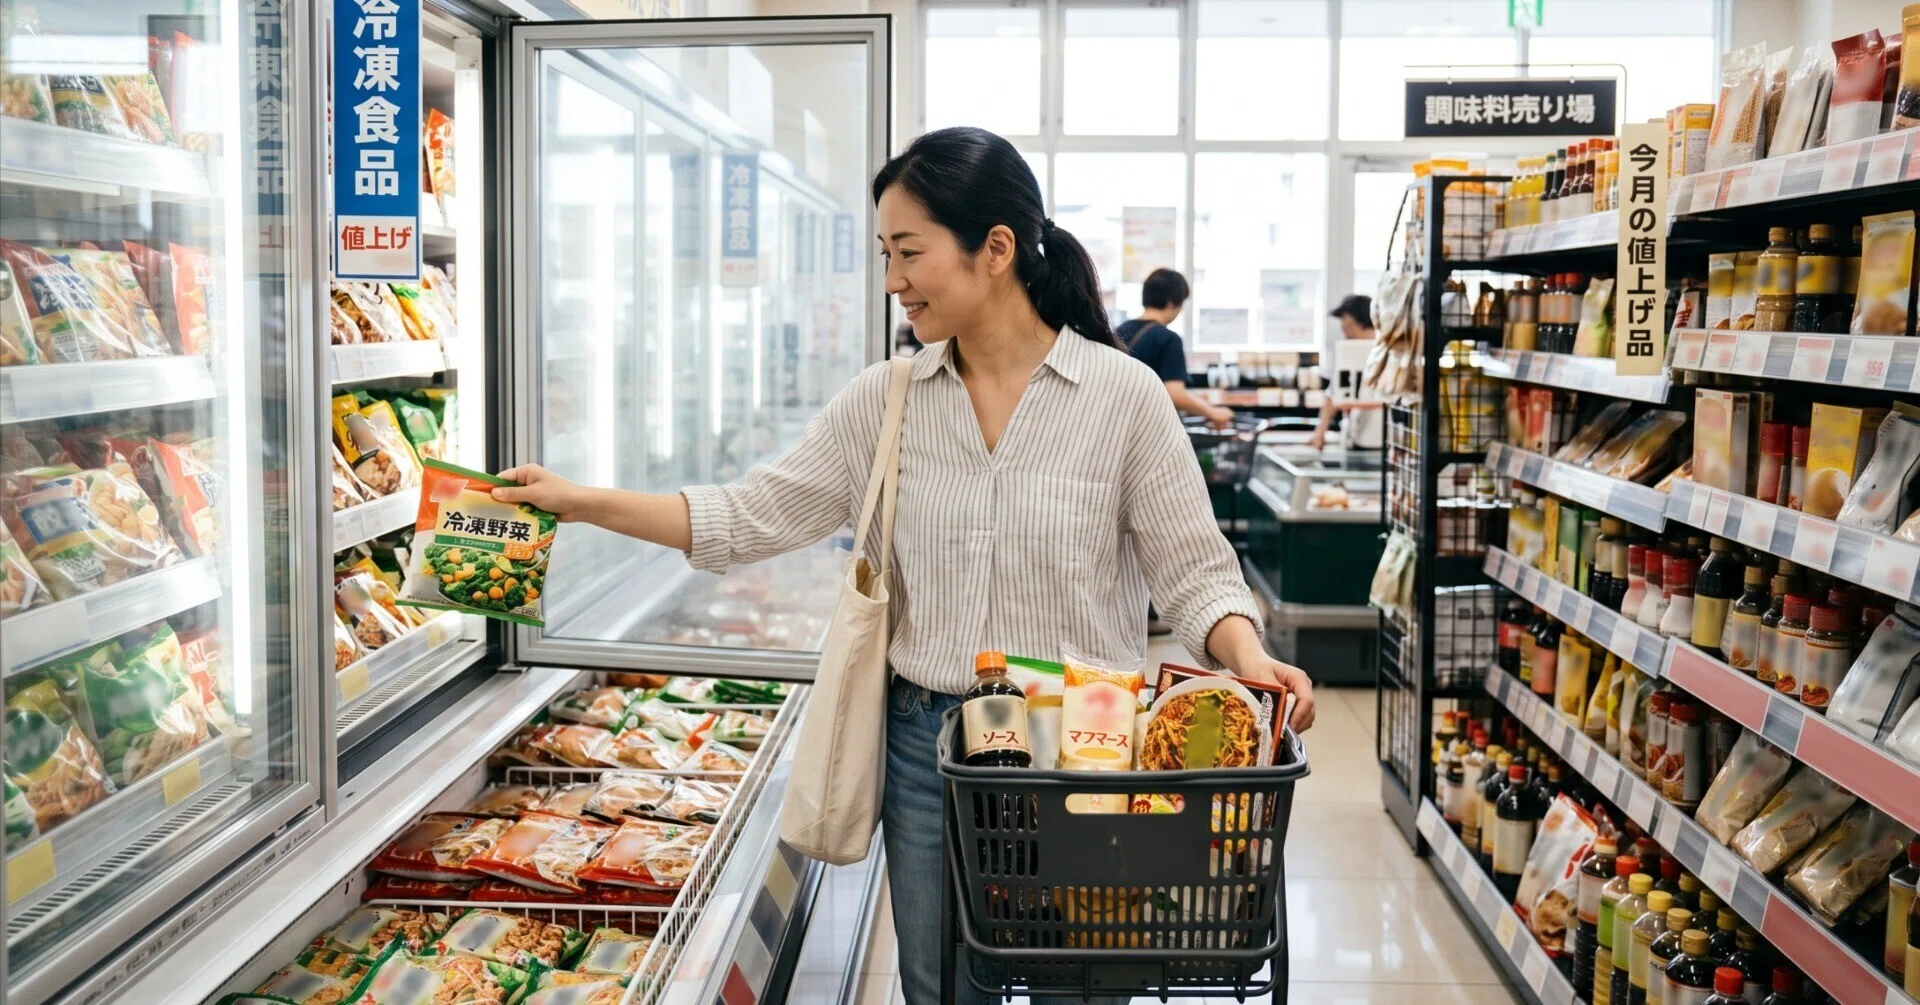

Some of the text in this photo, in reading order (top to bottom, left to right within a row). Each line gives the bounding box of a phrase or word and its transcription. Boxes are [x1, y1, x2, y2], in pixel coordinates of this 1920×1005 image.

[353, 0, 401, 196] 冷凍食品
[1425, 94, 1596, 125] 調味料売り場
[341, 225, 413, 251] 値上げ
[1627, 143, 1659, 357] 今月の値上げ品
[443, 511, 531, 541] 冷凍野菜
[983, 731, 1019, 744] ソース
